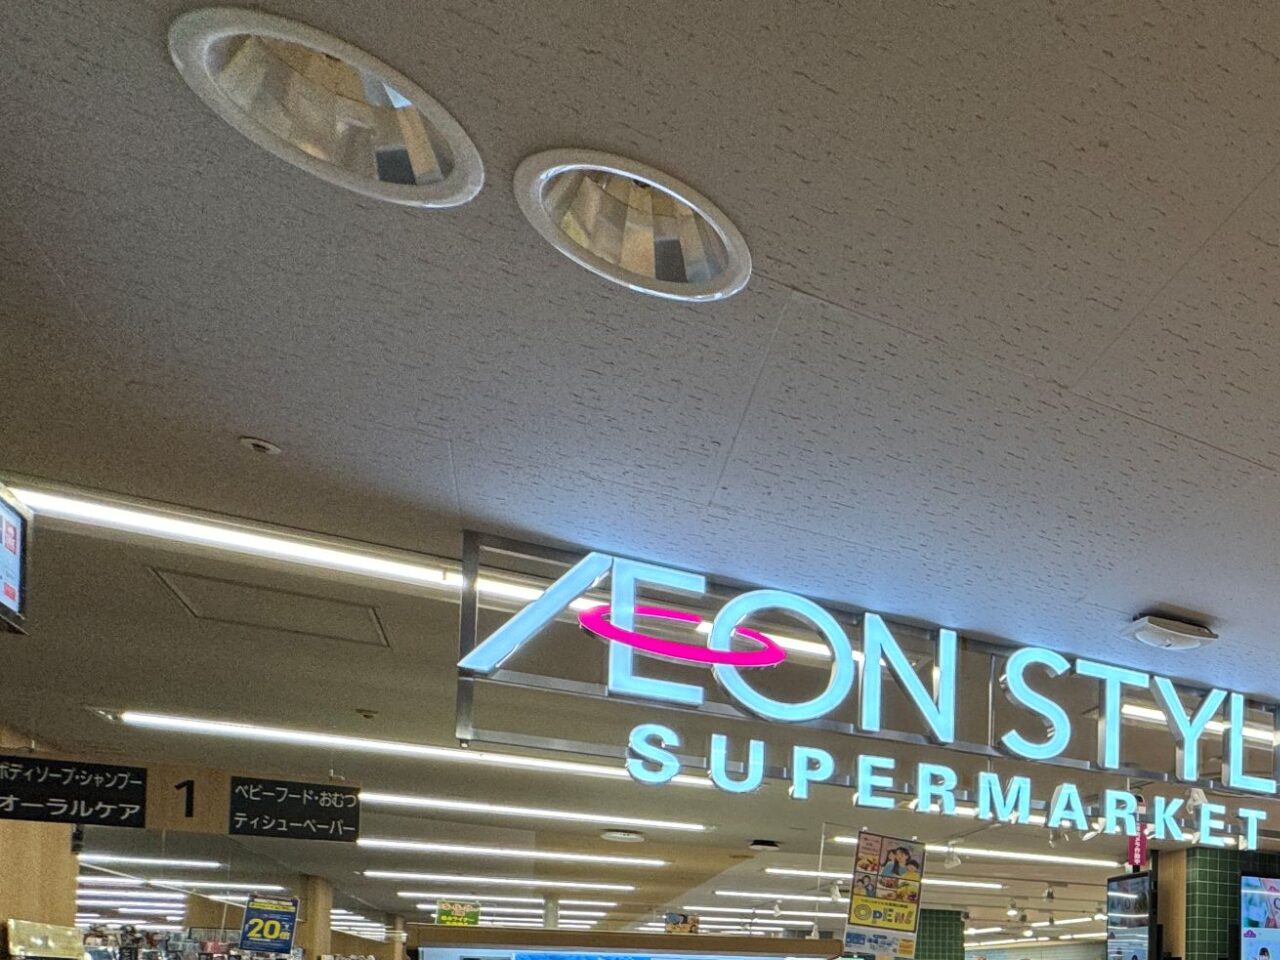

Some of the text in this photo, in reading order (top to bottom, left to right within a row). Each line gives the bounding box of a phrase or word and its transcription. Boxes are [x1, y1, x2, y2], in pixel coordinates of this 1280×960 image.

[174, 779, 195, 818] 1
[235, 784, 358, 808] ベビーフード・おむつ
[627, 724, 1268, 850] SUPERMARKET
[0, 795, 140, 820] オーラルケア
[247, 918, 281, 939] 20
